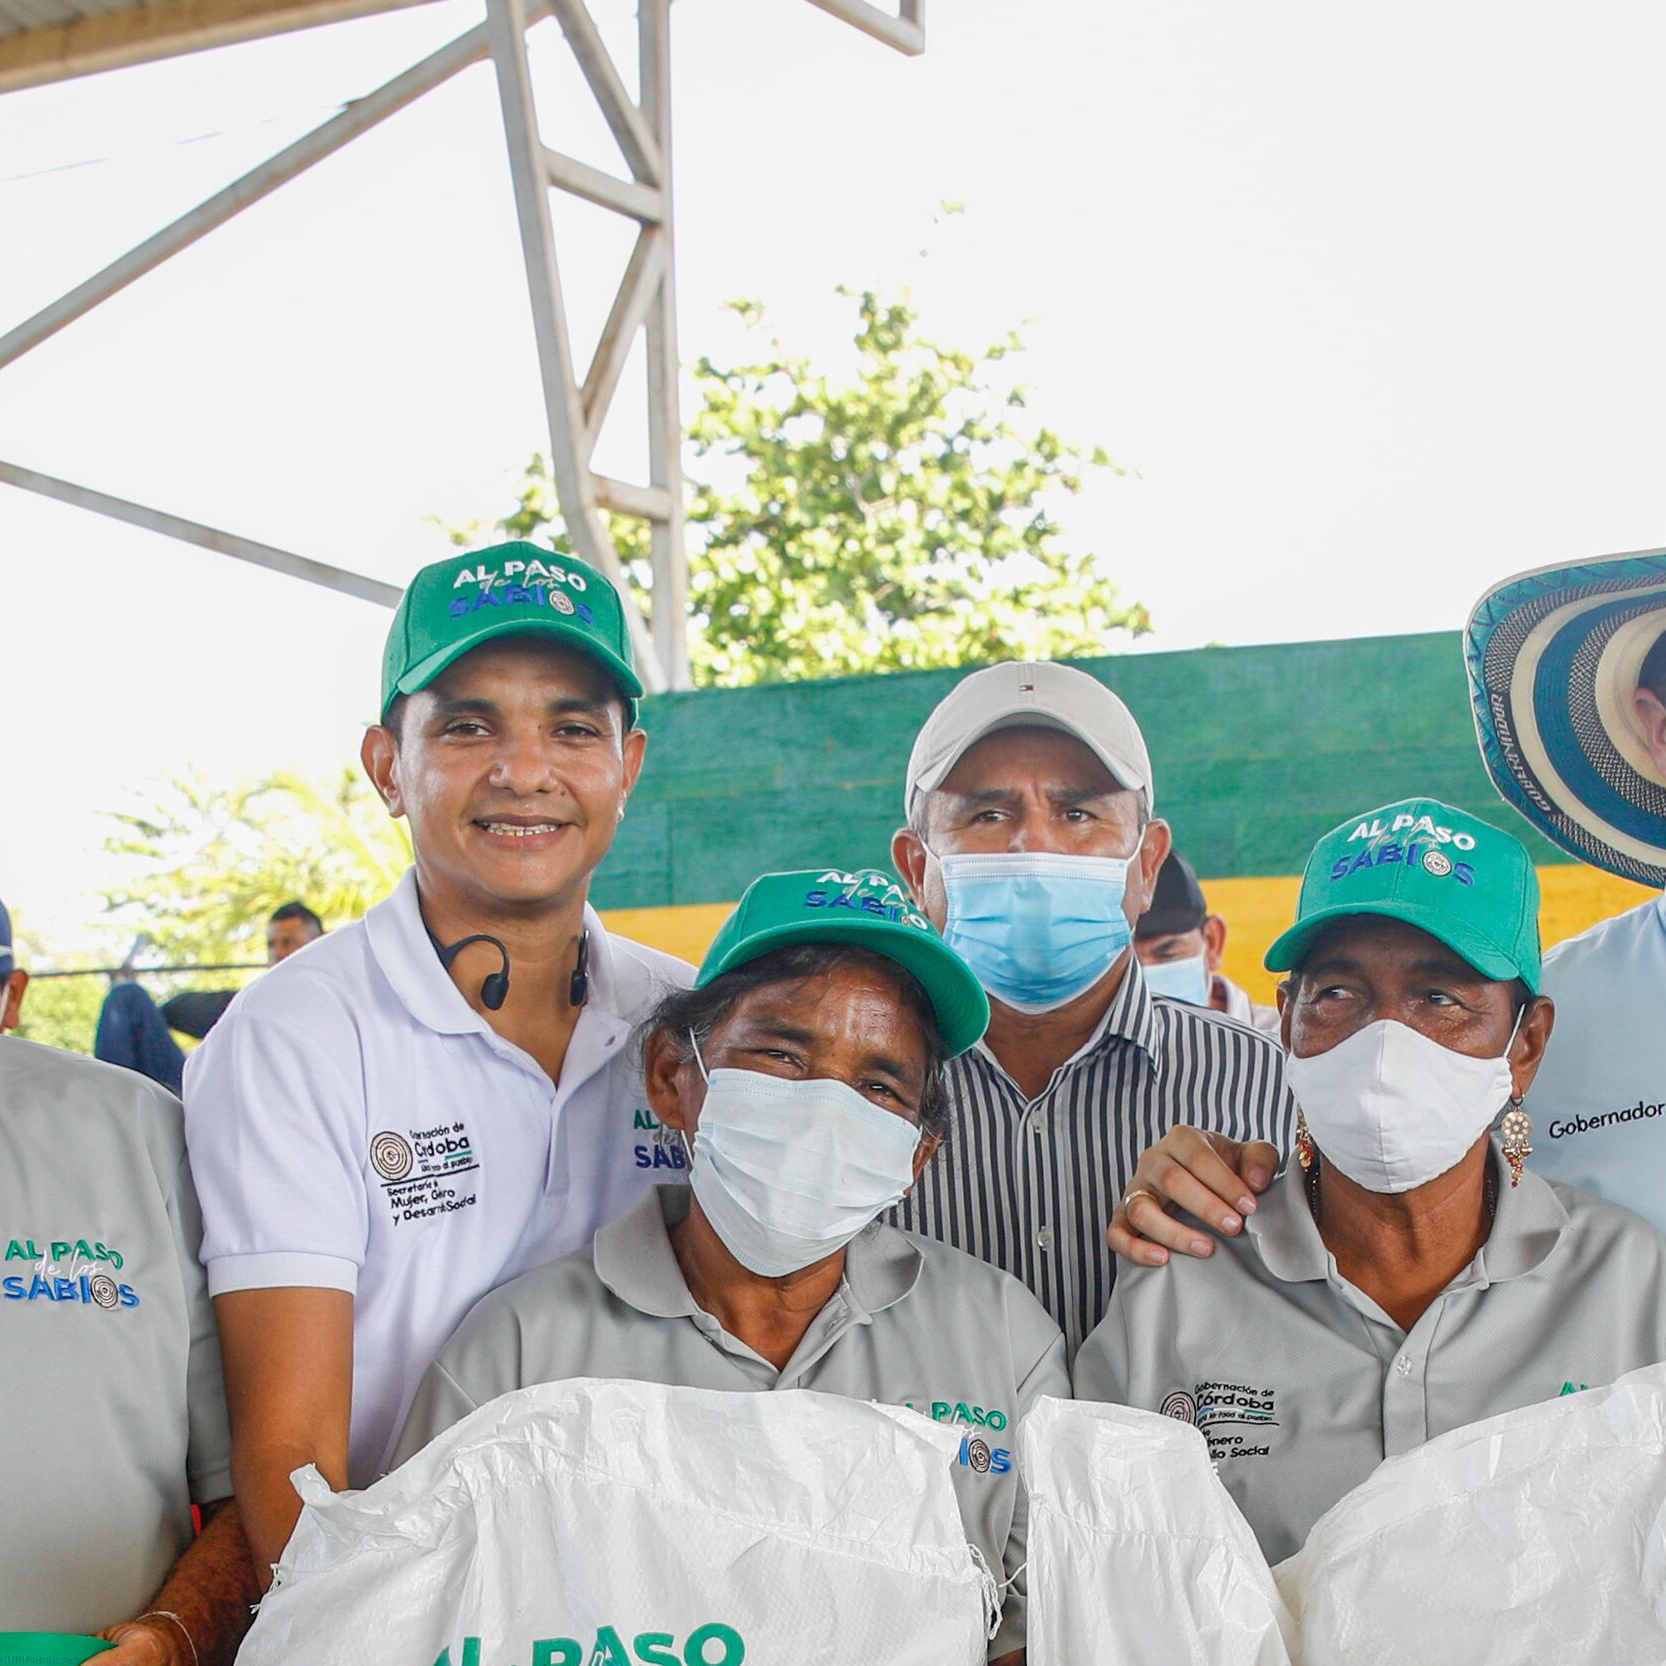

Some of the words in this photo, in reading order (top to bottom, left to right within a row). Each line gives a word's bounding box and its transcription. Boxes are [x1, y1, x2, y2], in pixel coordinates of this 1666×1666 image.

[453, 566, 494, 589] AL
[504, 560, 587, 591] PASO
[1348, 819, 1386, 842] AL
[1392, 814, 1475, 851] PASO
[634, 1109, 660, 1129] AL
[1549, 1101, 1666, 1139] Gobernador
[5, 1240, 43, 1261] AL
[1197, 1391, 1274, 1411] Córdoba
[1230, 1446, 1269, 1458] Social
